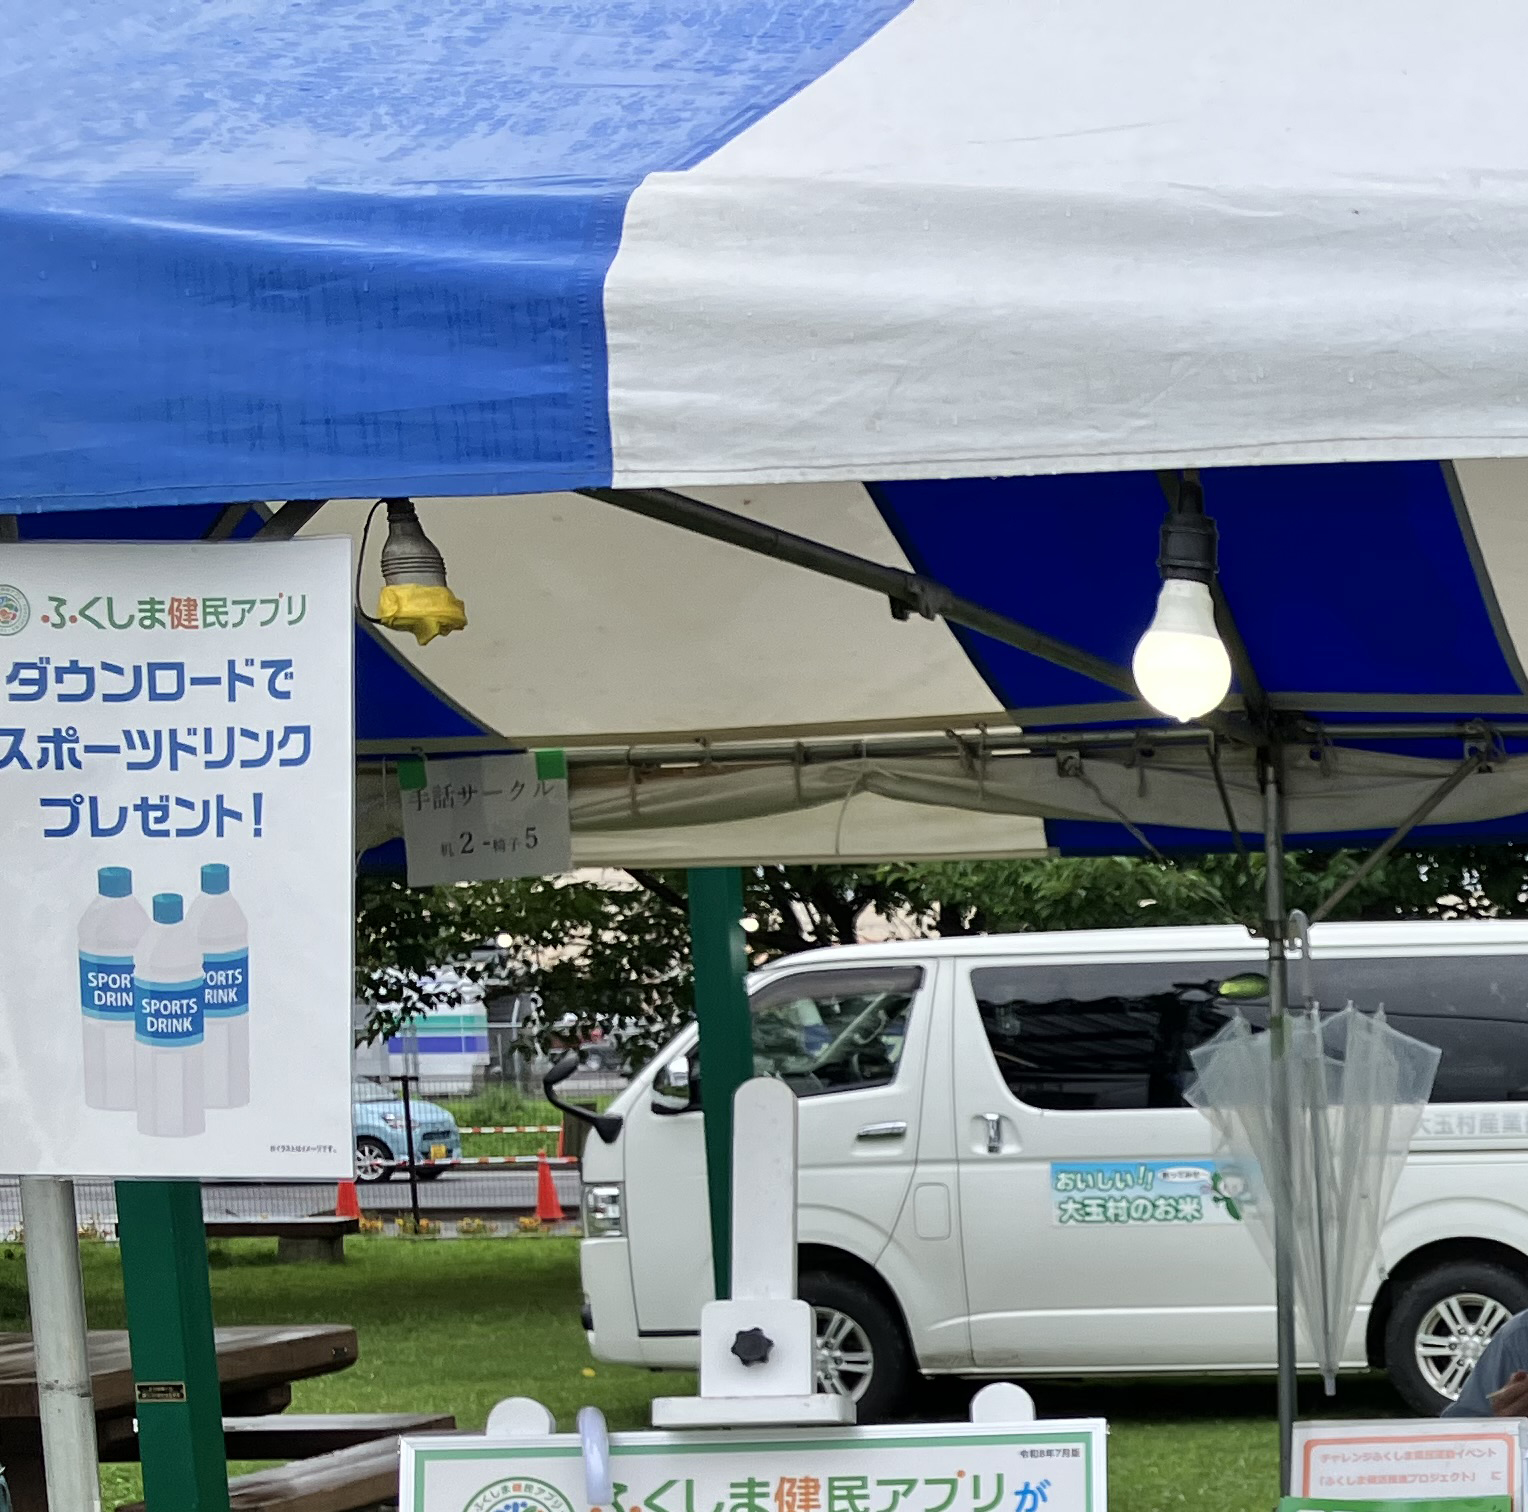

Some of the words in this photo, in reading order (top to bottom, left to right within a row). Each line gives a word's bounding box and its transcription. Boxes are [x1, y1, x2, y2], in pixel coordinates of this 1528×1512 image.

[41, 592, 306, 629] ふくしま健民アプリ
[6, 657, 293, 702] ダウンロードで
[0, 725, 311, 771] スポーツドリンク
[40, 792, 263, 838] プレゼント!
[88, 972, 134, 989] SPOR
[203, 968, 242, 987] ORTS
[94, 990, 133, 1007] DRIN
[204, 988, 238, 1004] RINK
[141, 998, 198, 1015] SPORTS
[146, 1016, 192, 1033] DRINK
[1058, 1196, 1203, 1223] 大玉村のお米
